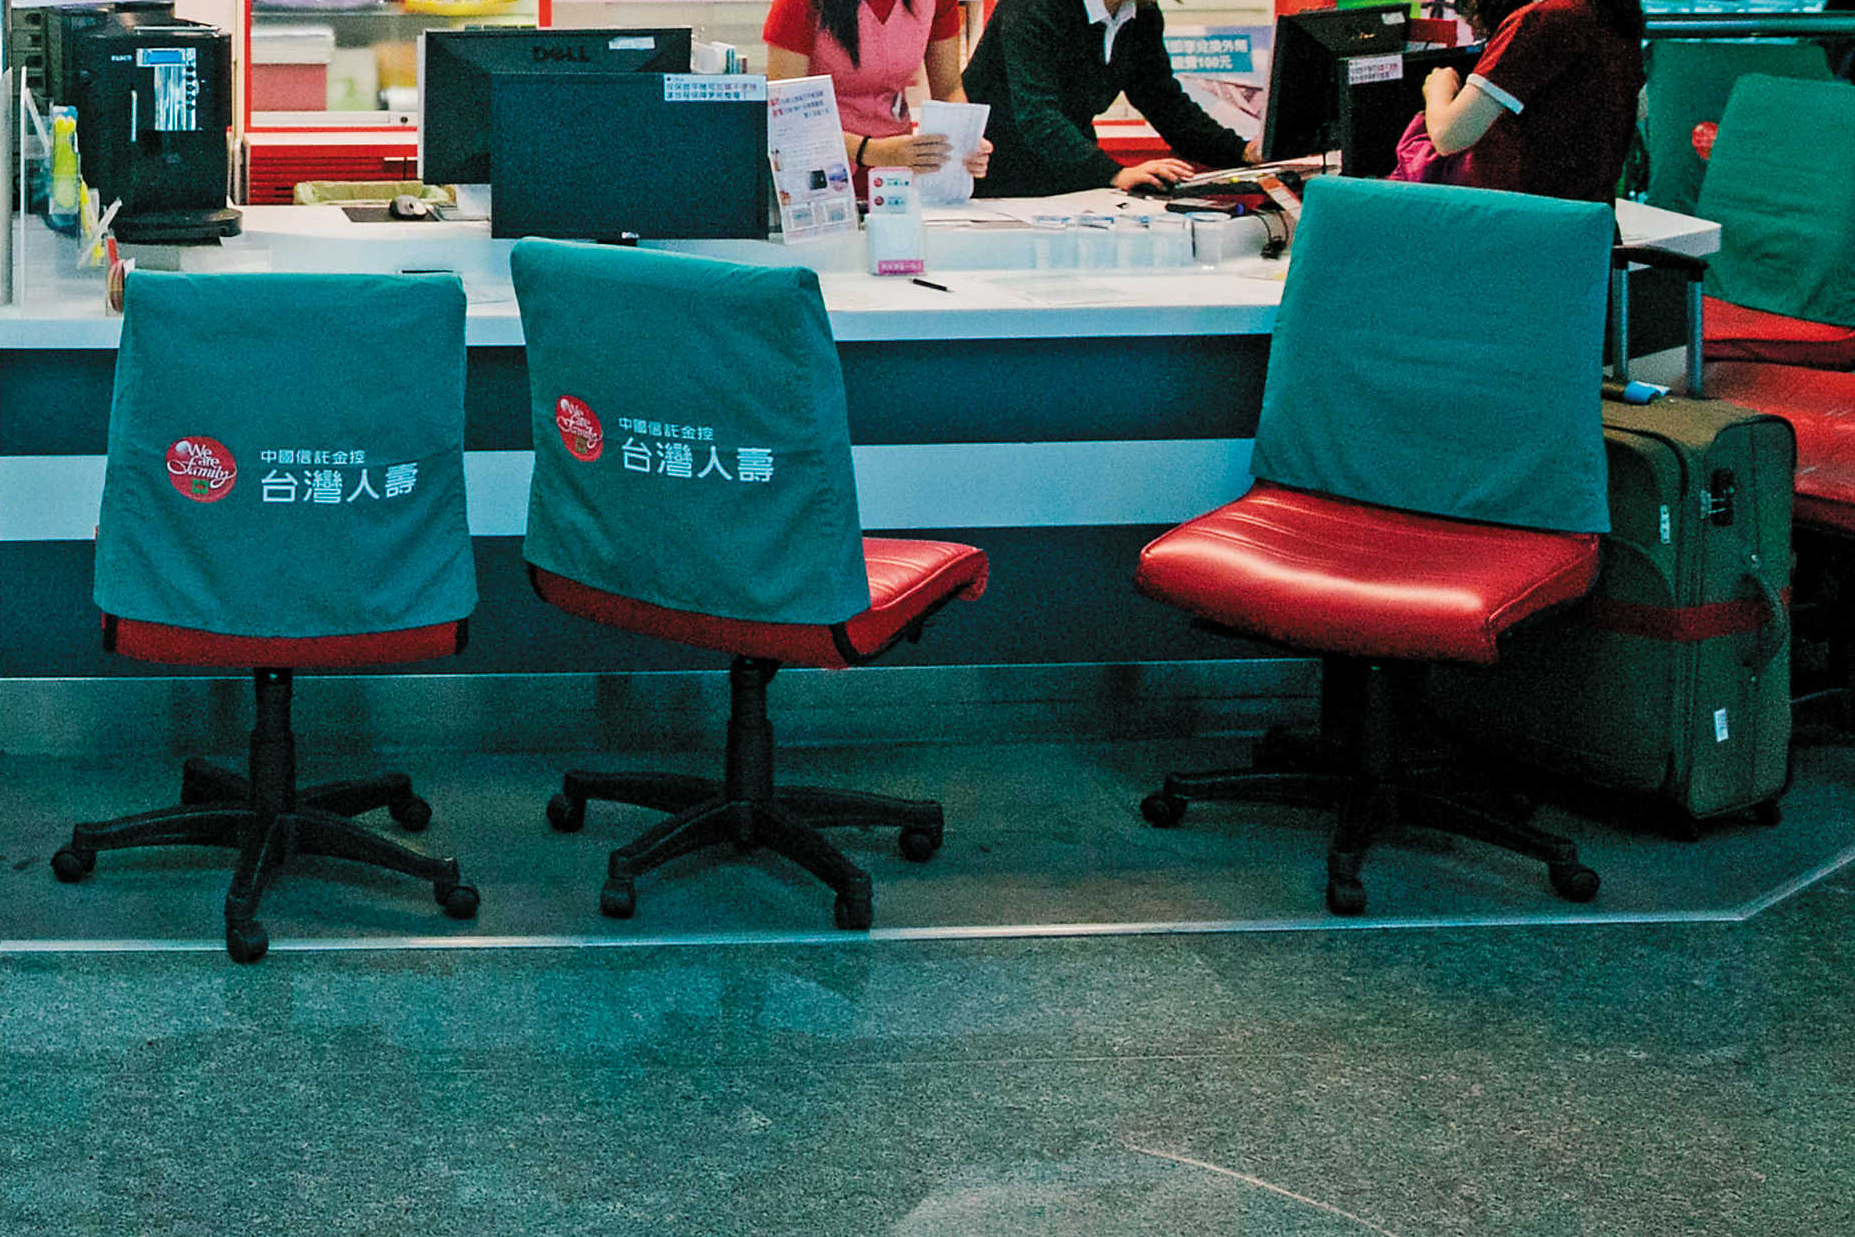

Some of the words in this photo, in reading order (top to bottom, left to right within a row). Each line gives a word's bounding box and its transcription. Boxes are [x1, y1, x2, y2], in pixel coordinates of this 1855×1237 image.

[618, 417, 715, 441] 中國信託金控
[260, 449, 367, 465] 中國信託金控
[621, 436, 775, 483] 台灣人壽
[260, 462, 419, 504] 台灣人壽
